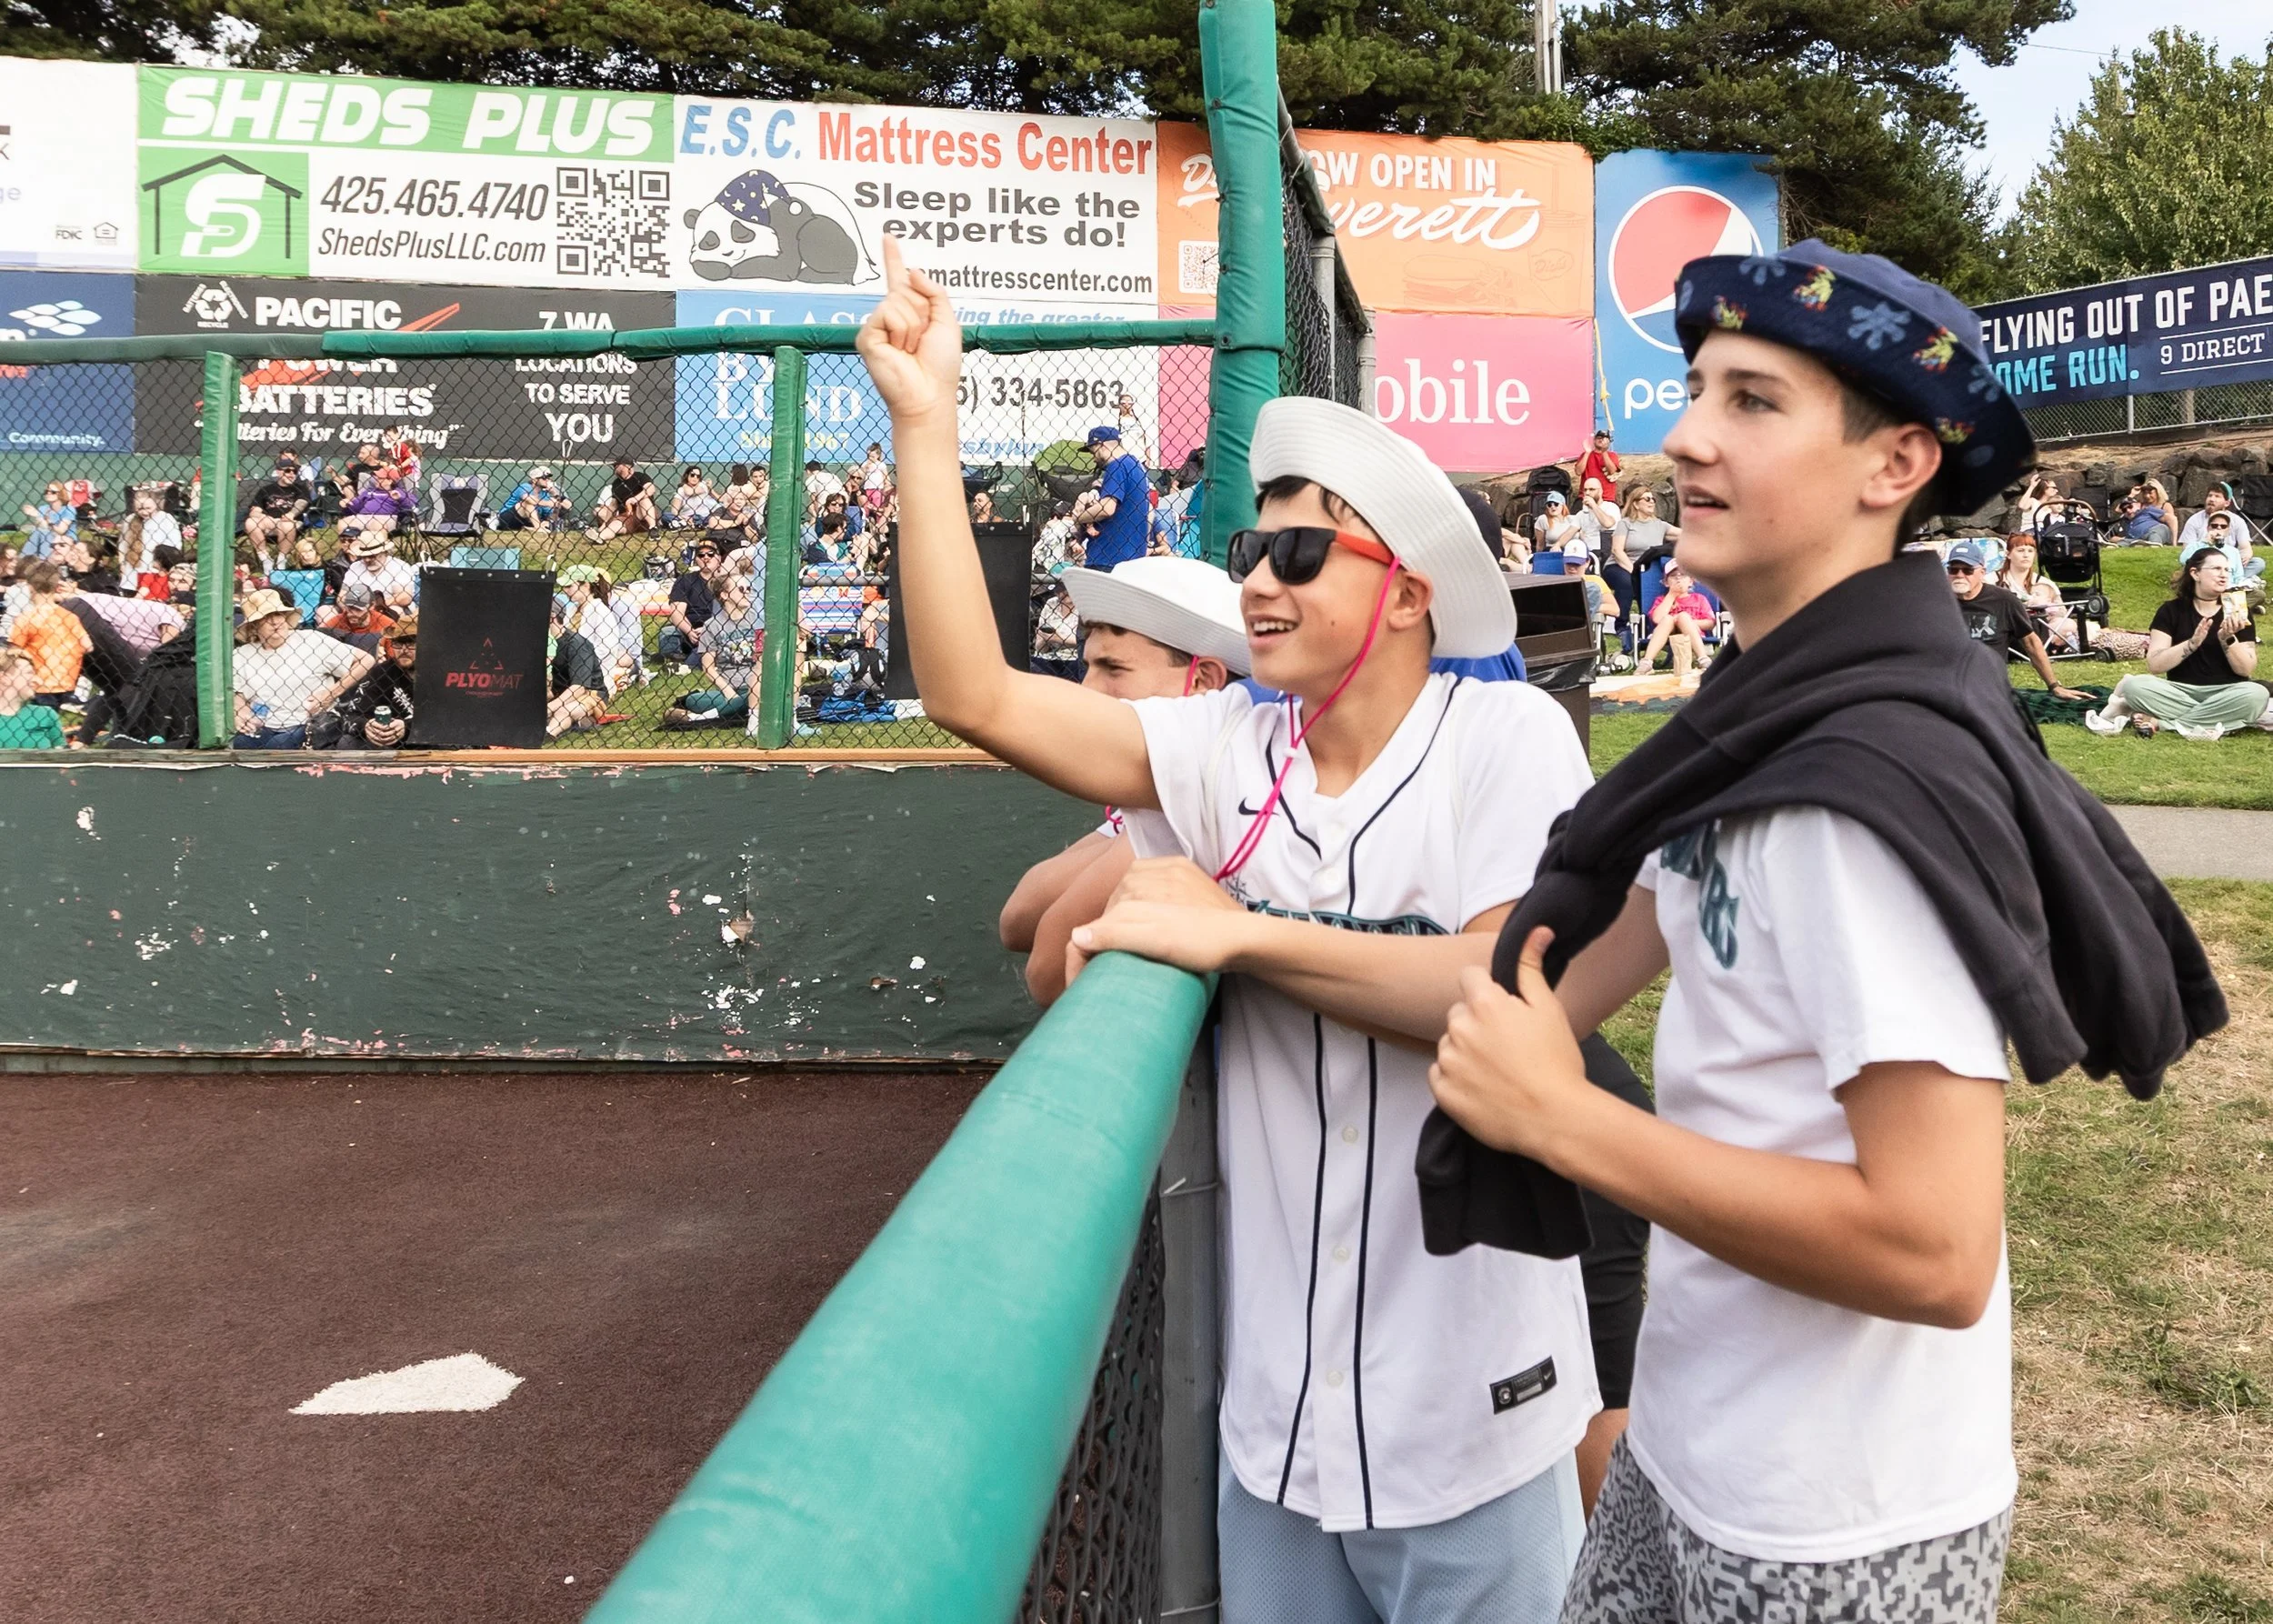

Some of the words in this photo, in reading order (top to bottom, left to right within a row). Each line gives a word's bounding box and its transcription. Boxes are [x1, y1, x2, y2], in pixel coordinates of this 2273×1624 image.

[161, 76, 433, 145] SHEDS
[462, 92, 656, 155] PLUS
[679, 105, 801, 159] E.S.C.
[818, 112, 1001, 168] Mattress
[1016, 121, 1152, 175] Center
[1370, 154, 1452, 189] OPEN
[1465, 159, 1496, 190] IN
[320, 175, 549, 221] 425.465.4740
[855, 182, 971, 218] Sleep
[988, 187, 1060, 216] like
[1076, 192, 1140, 218] the
[883, 218, 1047, 248] experts
[1064, 221, 1125, 247] do!
[1328, 187, 1542, 250] verett
[318, 227, 546, 263] ShedsPlusLLC.com
[906, 265, 1152, 293] mattresscenter.com
[255, 296, 402, 329] PACIFIC
[565, 312, 615, 331] WA
[997, 308, 1034, 325] the
[2088, 294, 2143, 338] OUT
[2155, 286, 2195, 329] OF
[2209, 274, 2273, 322] PAE
[2160, 345, 2173, 365] 9
[2181, 333, 2265, 363] DIRECT
[1988, 355, 2057, 395] OME
[2068, 345, 2139, 388] RUN.
[525, 383, 555, 403] TO
[559, 384, 630, 405] SERVE
[990, 376, 1124, 409] 334-5863
[1375, 358, 1530, 426] obile
[8, 432, 105, 446] Community.
[301, 422, 335, 441] For
[545, 413, 614, 443] YOU
[445, 672, 524, 689] PLYOMAT
